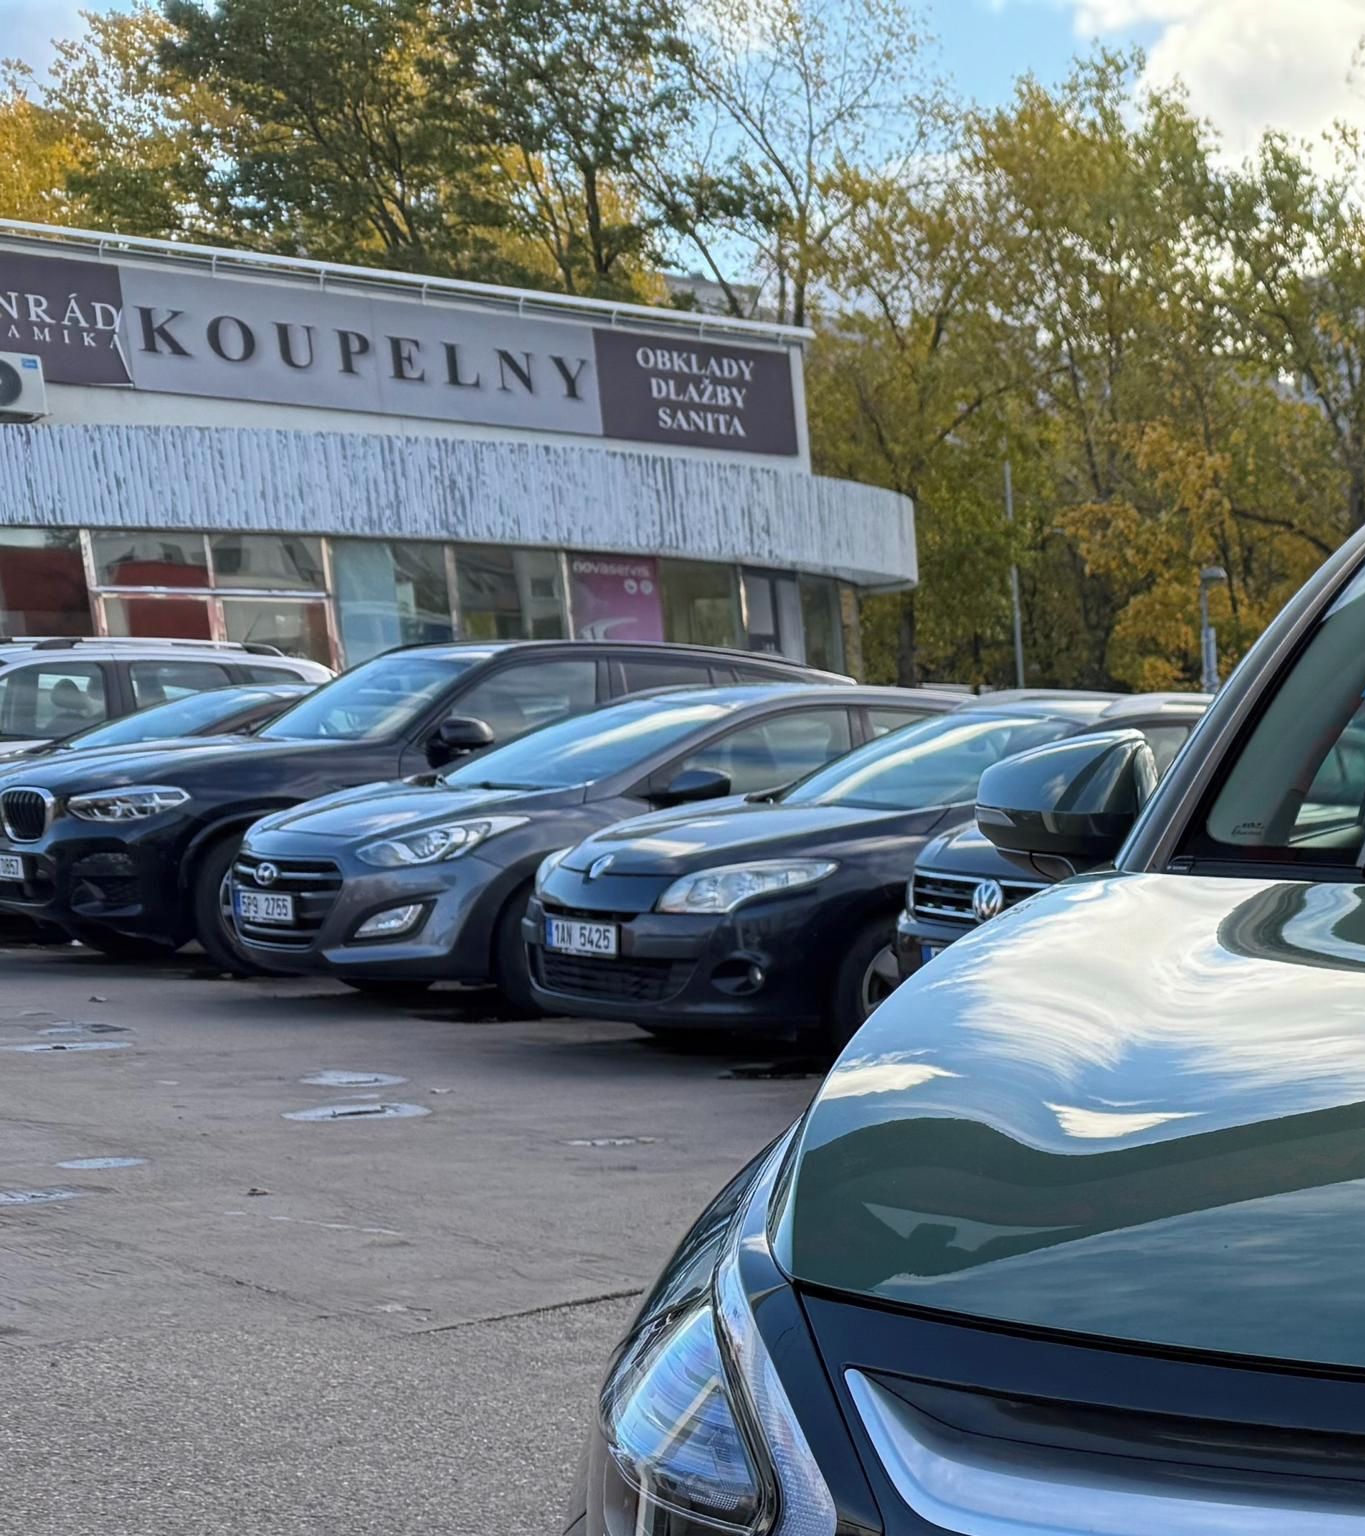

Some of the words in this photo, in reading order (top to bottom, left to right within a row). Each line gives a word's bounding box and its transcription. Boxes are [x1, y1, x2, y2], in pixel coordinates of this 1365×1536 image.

[133, 305, 588, 399] KOUPELNY
[636, 346, 754, 382] OBKLADY
[650, 377, 747, 409] DLAŽBY
[658, 406, 747, 438] SANITA
[555, 923, 572, 945] 1AN
[579, 926, 610, 950] 5425
